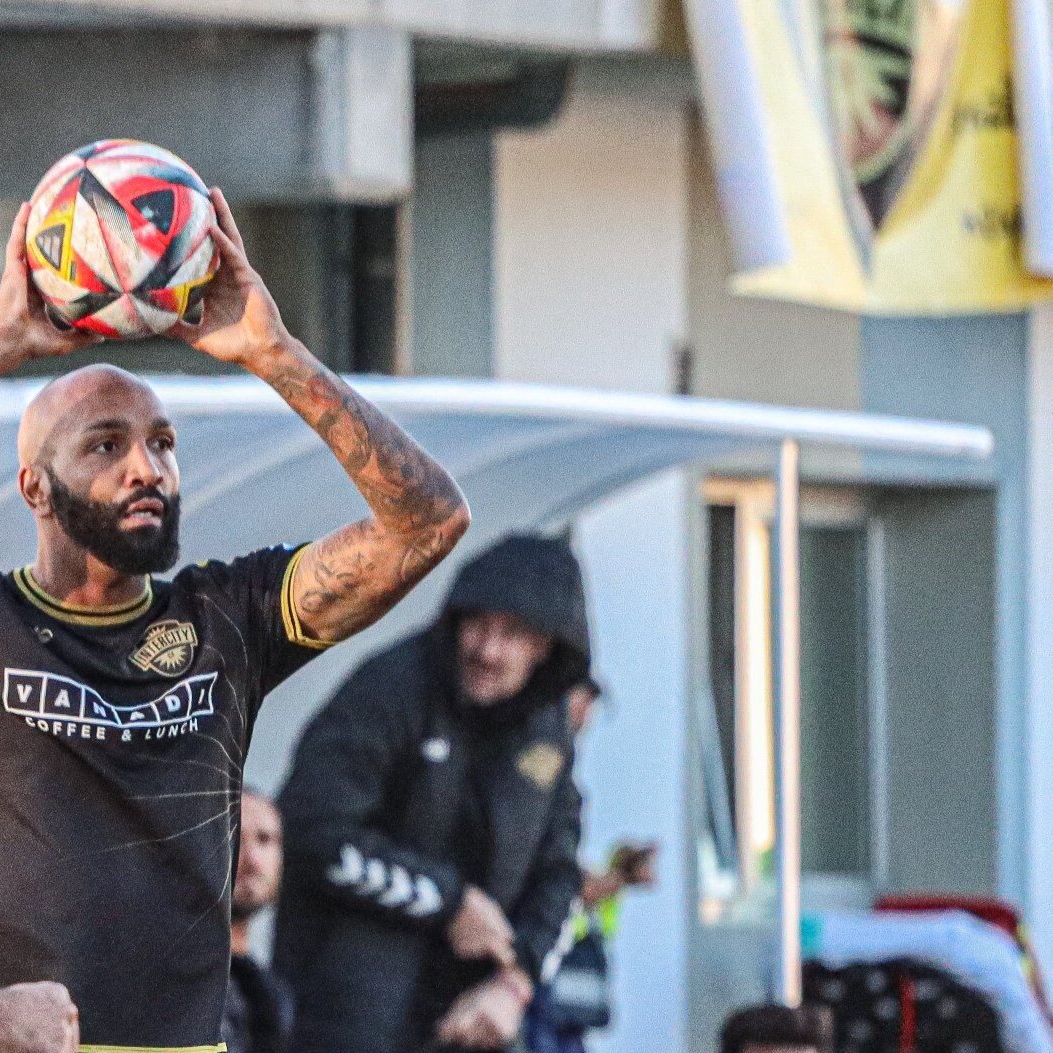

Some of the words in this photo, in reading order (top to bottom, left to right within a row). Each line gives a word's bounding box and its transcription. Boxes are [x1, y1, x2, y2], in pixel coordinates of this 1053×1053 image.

[138, 628, 189, 663] INTERCITY
[15, 683, 205, 720] VANADI
[24, 716, 107, 740] COFFEE
[121, 727, 133, 741] &
[144, 717, 199, 739] LUNCH
